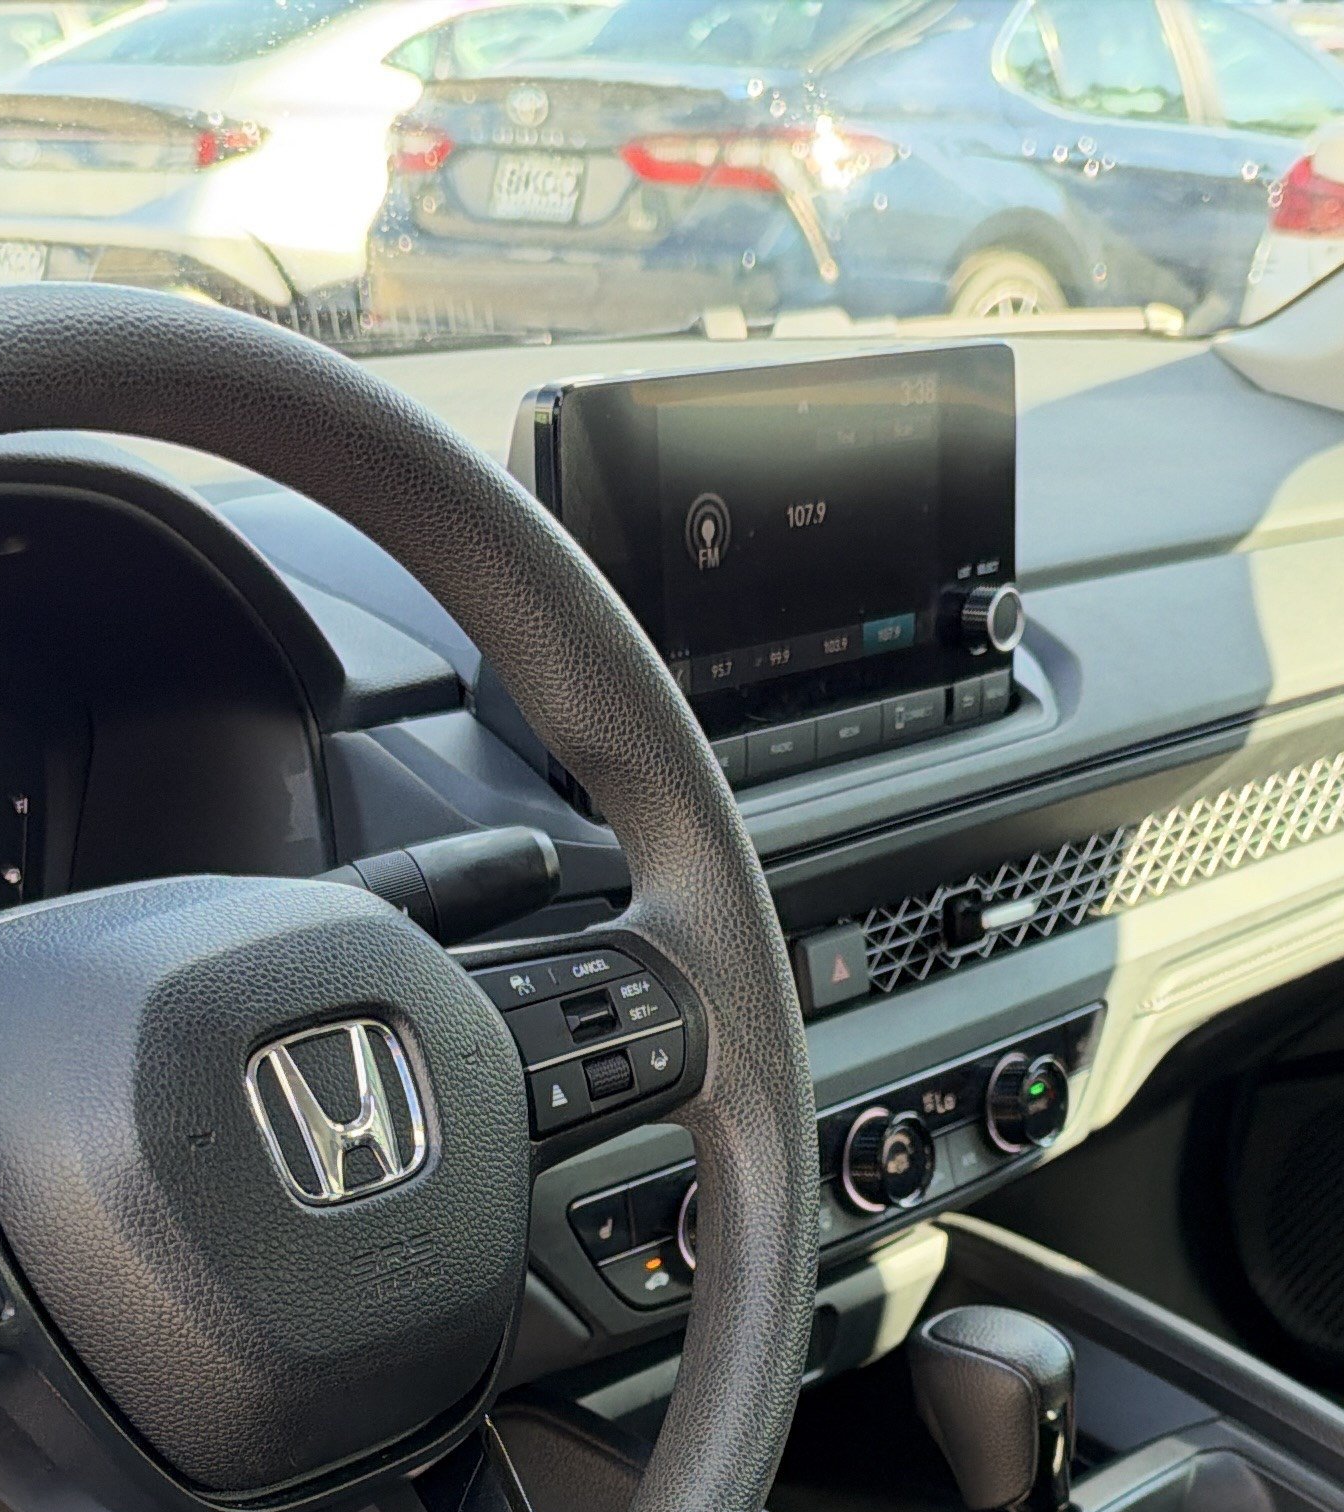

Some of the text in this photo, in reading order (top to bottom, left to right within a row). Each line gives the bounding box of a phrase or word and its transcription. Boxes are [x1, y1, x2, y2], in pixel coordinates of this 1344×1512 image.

[786, 501, 827, 528] 107.9
[699, 547, 721, 571] FM
[572, 958, 611, 979] CANCEL
[620, 980, 652, 999] RES/+
